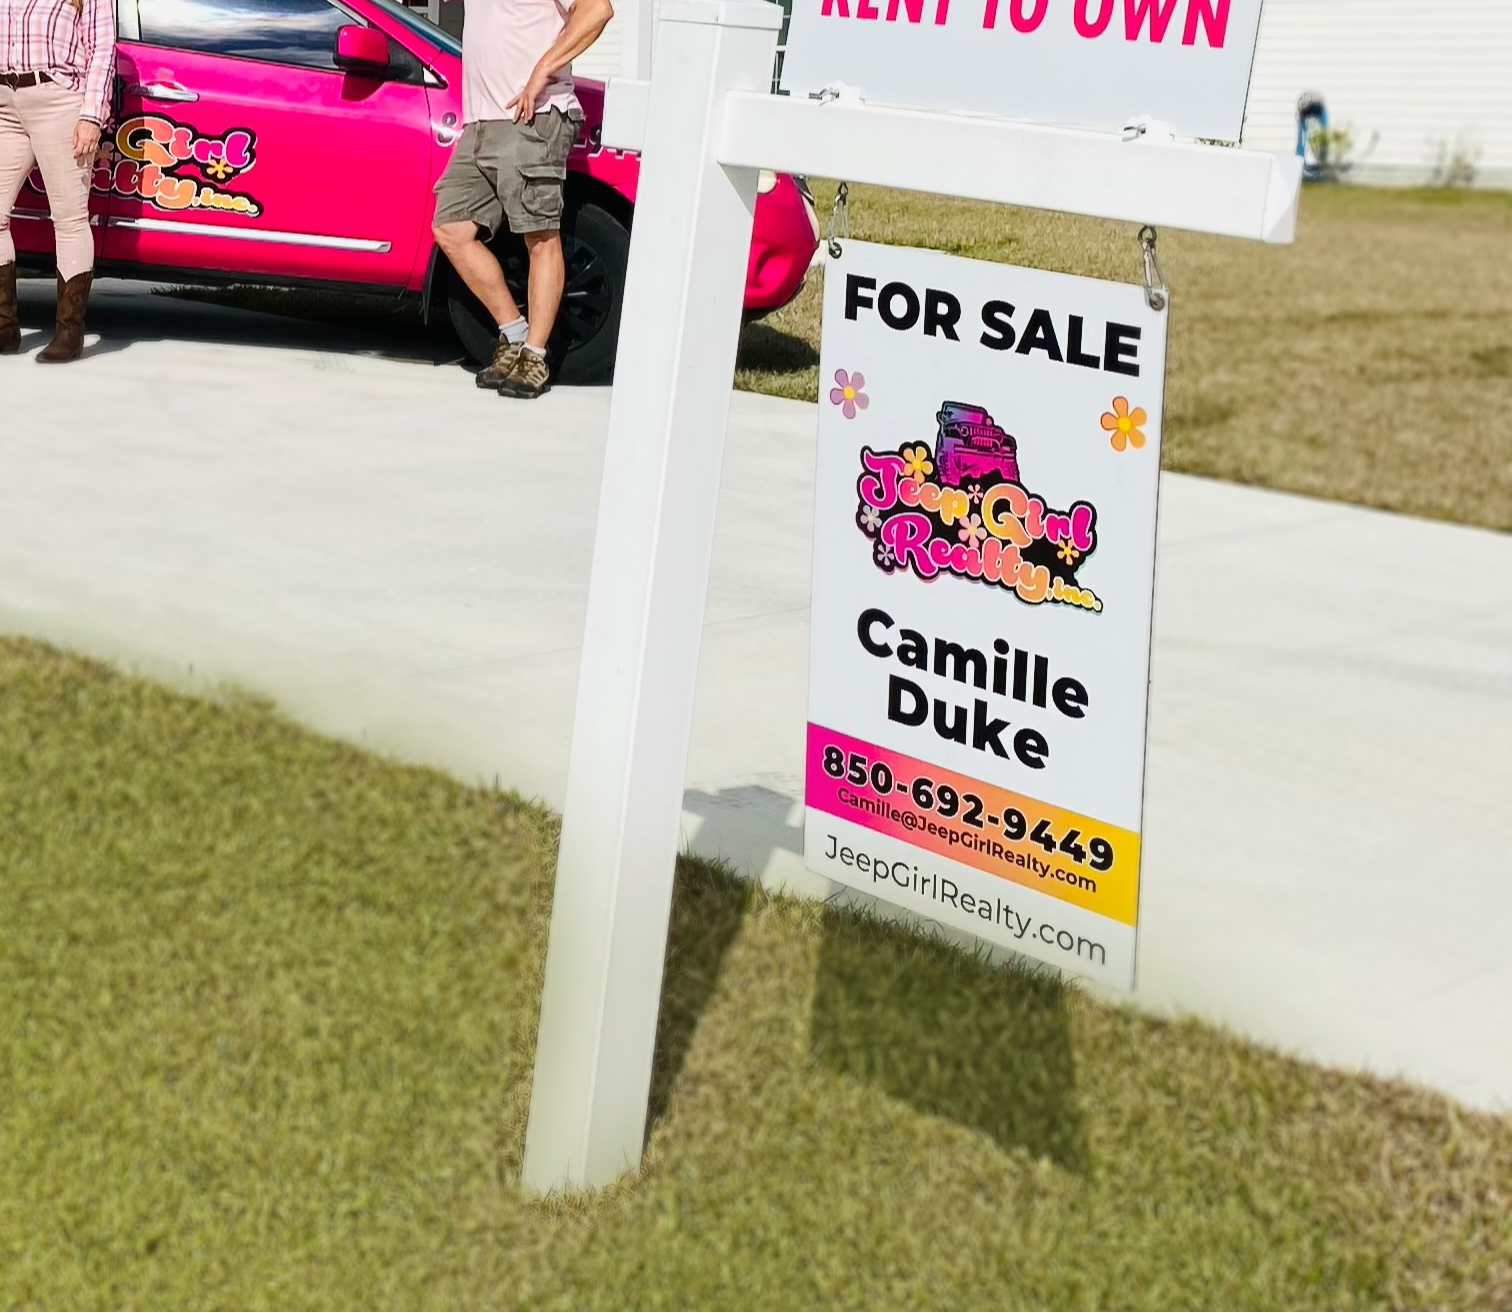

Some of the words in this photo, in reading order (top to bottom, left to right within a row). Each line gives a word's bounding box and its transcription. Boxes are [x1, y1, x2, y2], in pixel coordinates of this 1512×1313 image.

[116, 115, 253, 169] Girl
[844, 272, 962, 342] FOR
[979, 299, 1142, 378] SALE
[859, 447, 971, 527] Jeep
[981, 482, 1094, 551] Girl
[857, 607, 1089, 719] Camille
[887, 673, 1050, 770] Duke
[821, 745, 1115, 873] 850-692-9449
[837, 786, 1097, 894] Camille@JeepGirlRealty.com
[824, 834, 1107, 965] JeepGirlRealty.com
